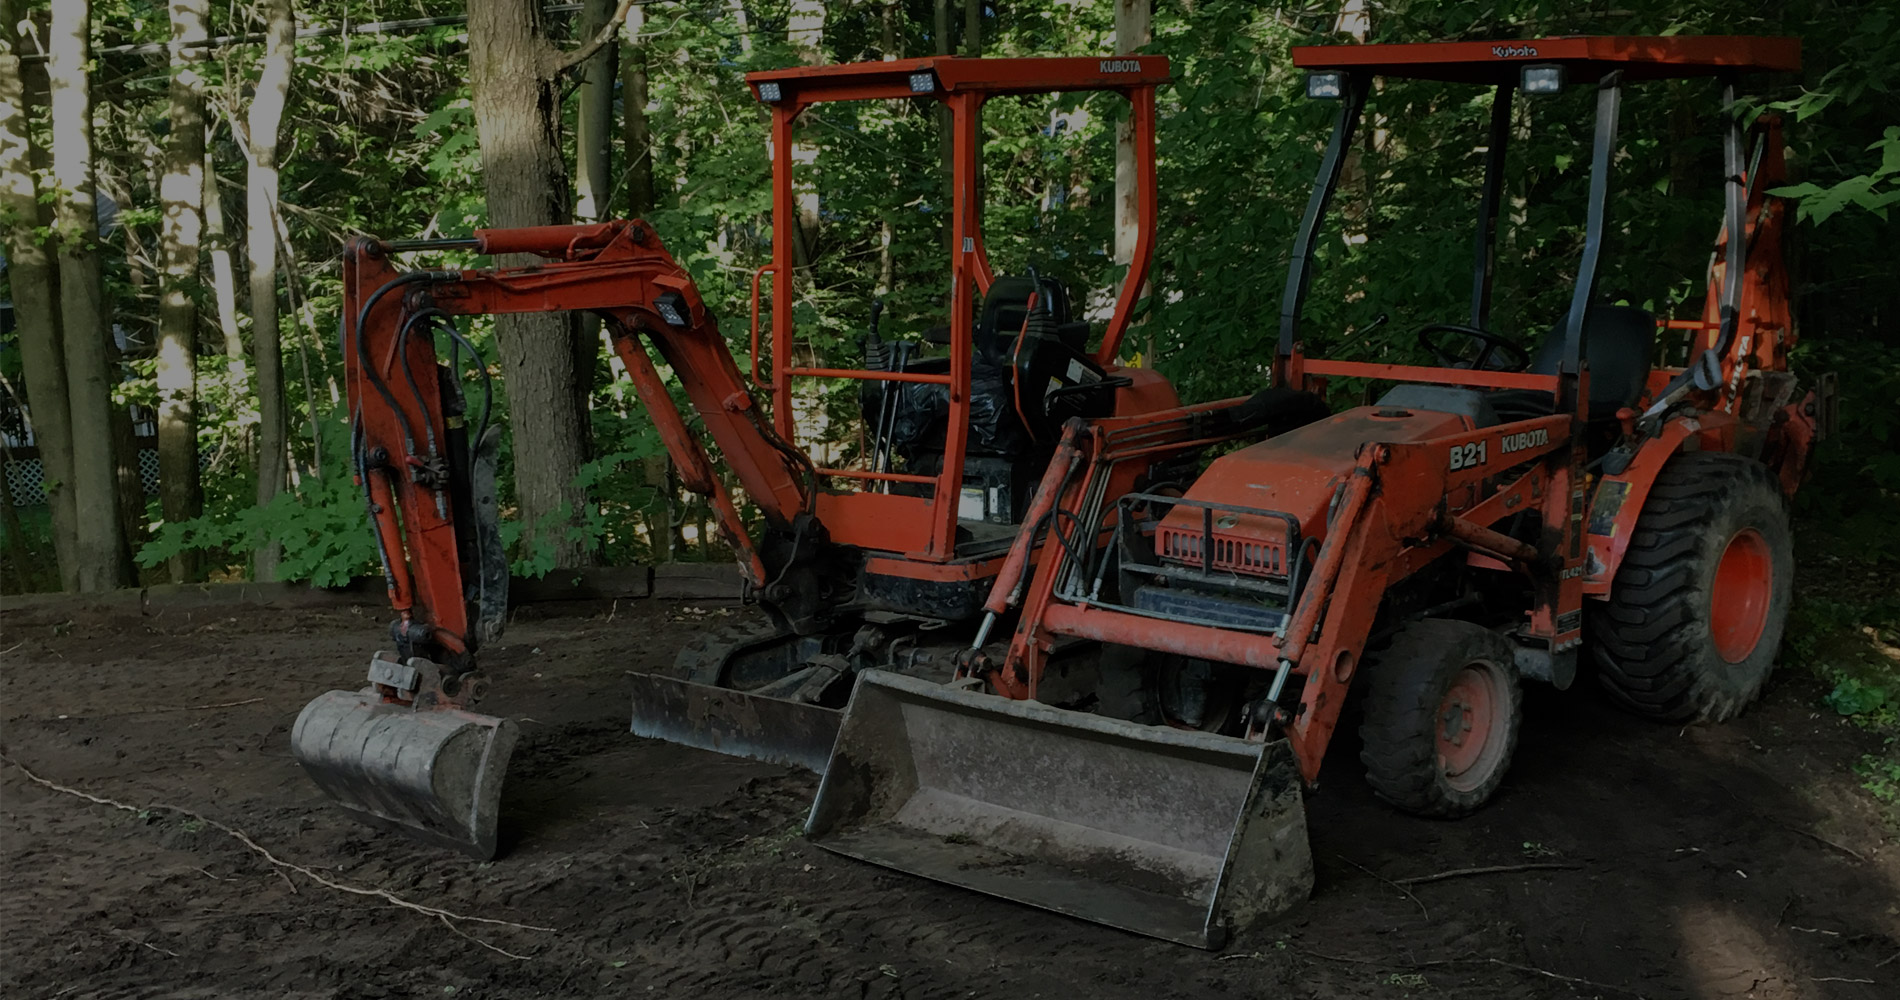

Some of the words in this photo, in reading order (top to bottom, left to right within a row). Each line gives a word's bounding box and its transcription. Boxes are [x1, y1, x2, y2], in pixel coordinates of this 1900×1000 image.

[1491, 46, 1538, 58] Kubota
[1100, 60, 1142, 73] KUBOTA
[1450, 440, 1487, 471] B21
[1501, 428, 1549, 454] KUBOTA
